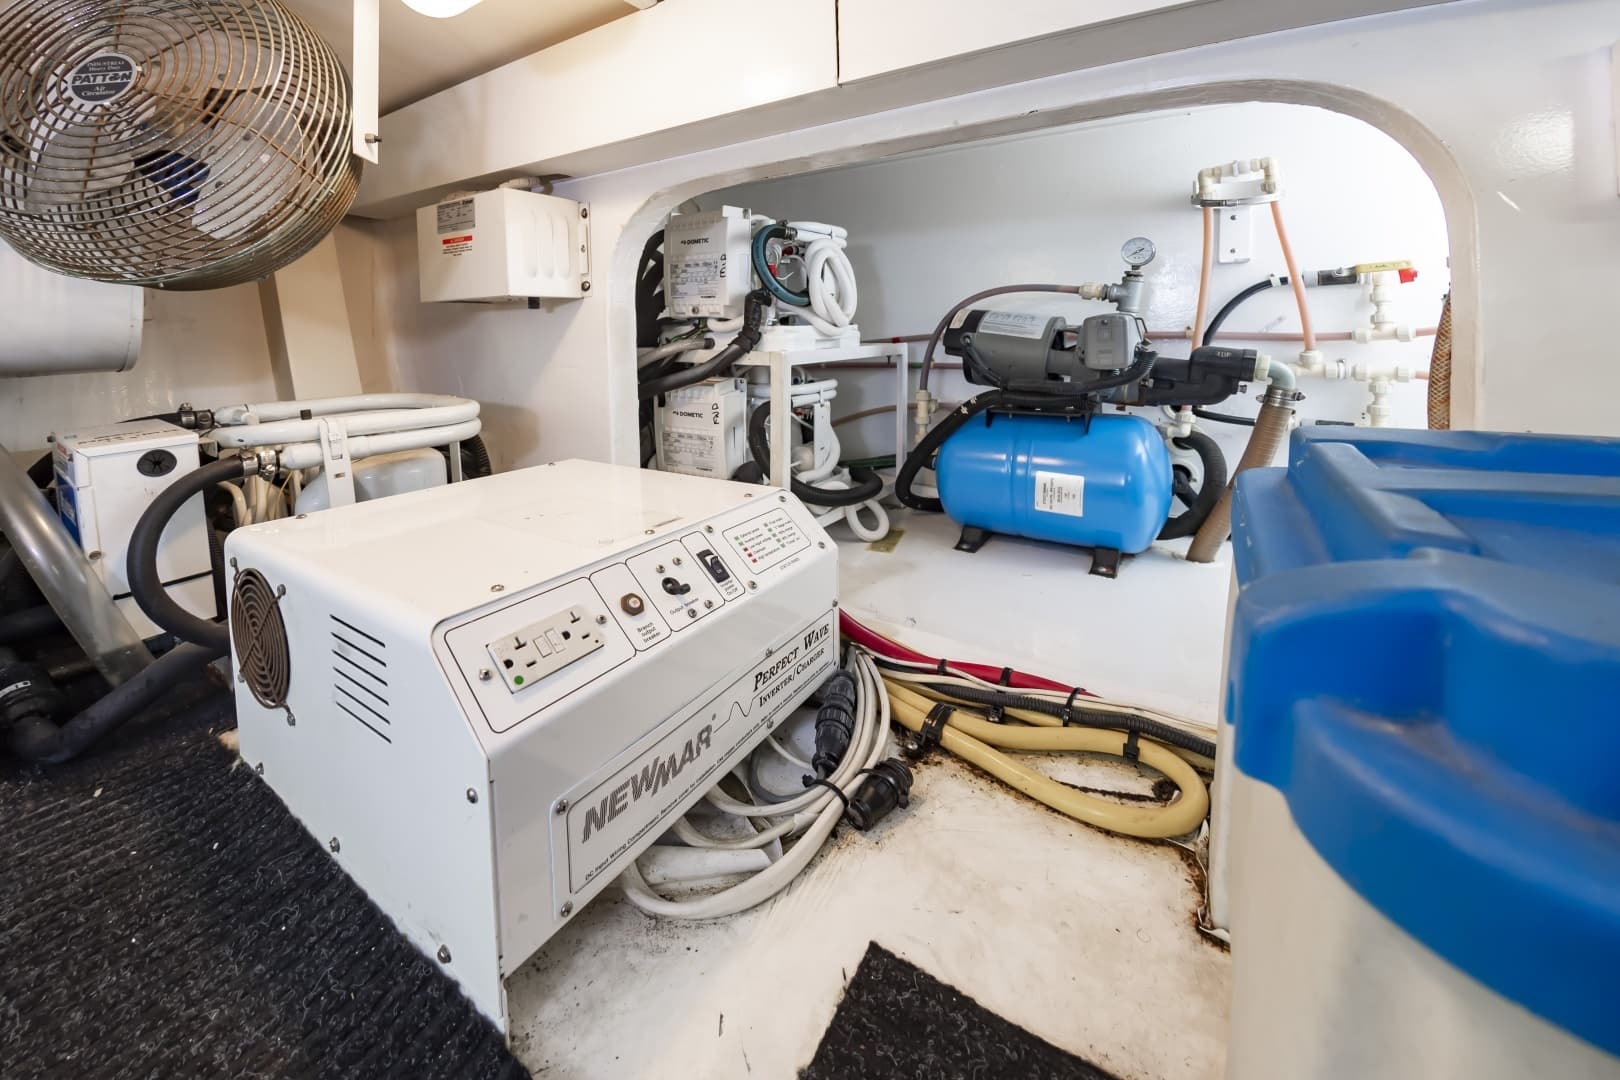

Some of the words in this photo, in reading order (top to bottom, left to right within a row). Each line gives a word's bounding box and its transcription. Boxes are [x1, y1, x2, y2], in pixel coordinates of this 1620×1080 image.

[72, 72, 132, 84] PATTON
[679, 410, 704, 419] DOMETIC
[753, 646, 800, 692] PERFECT
[803, 623, 829, 650] WAVE
[581, 723, 713, 844] NEWMAR
